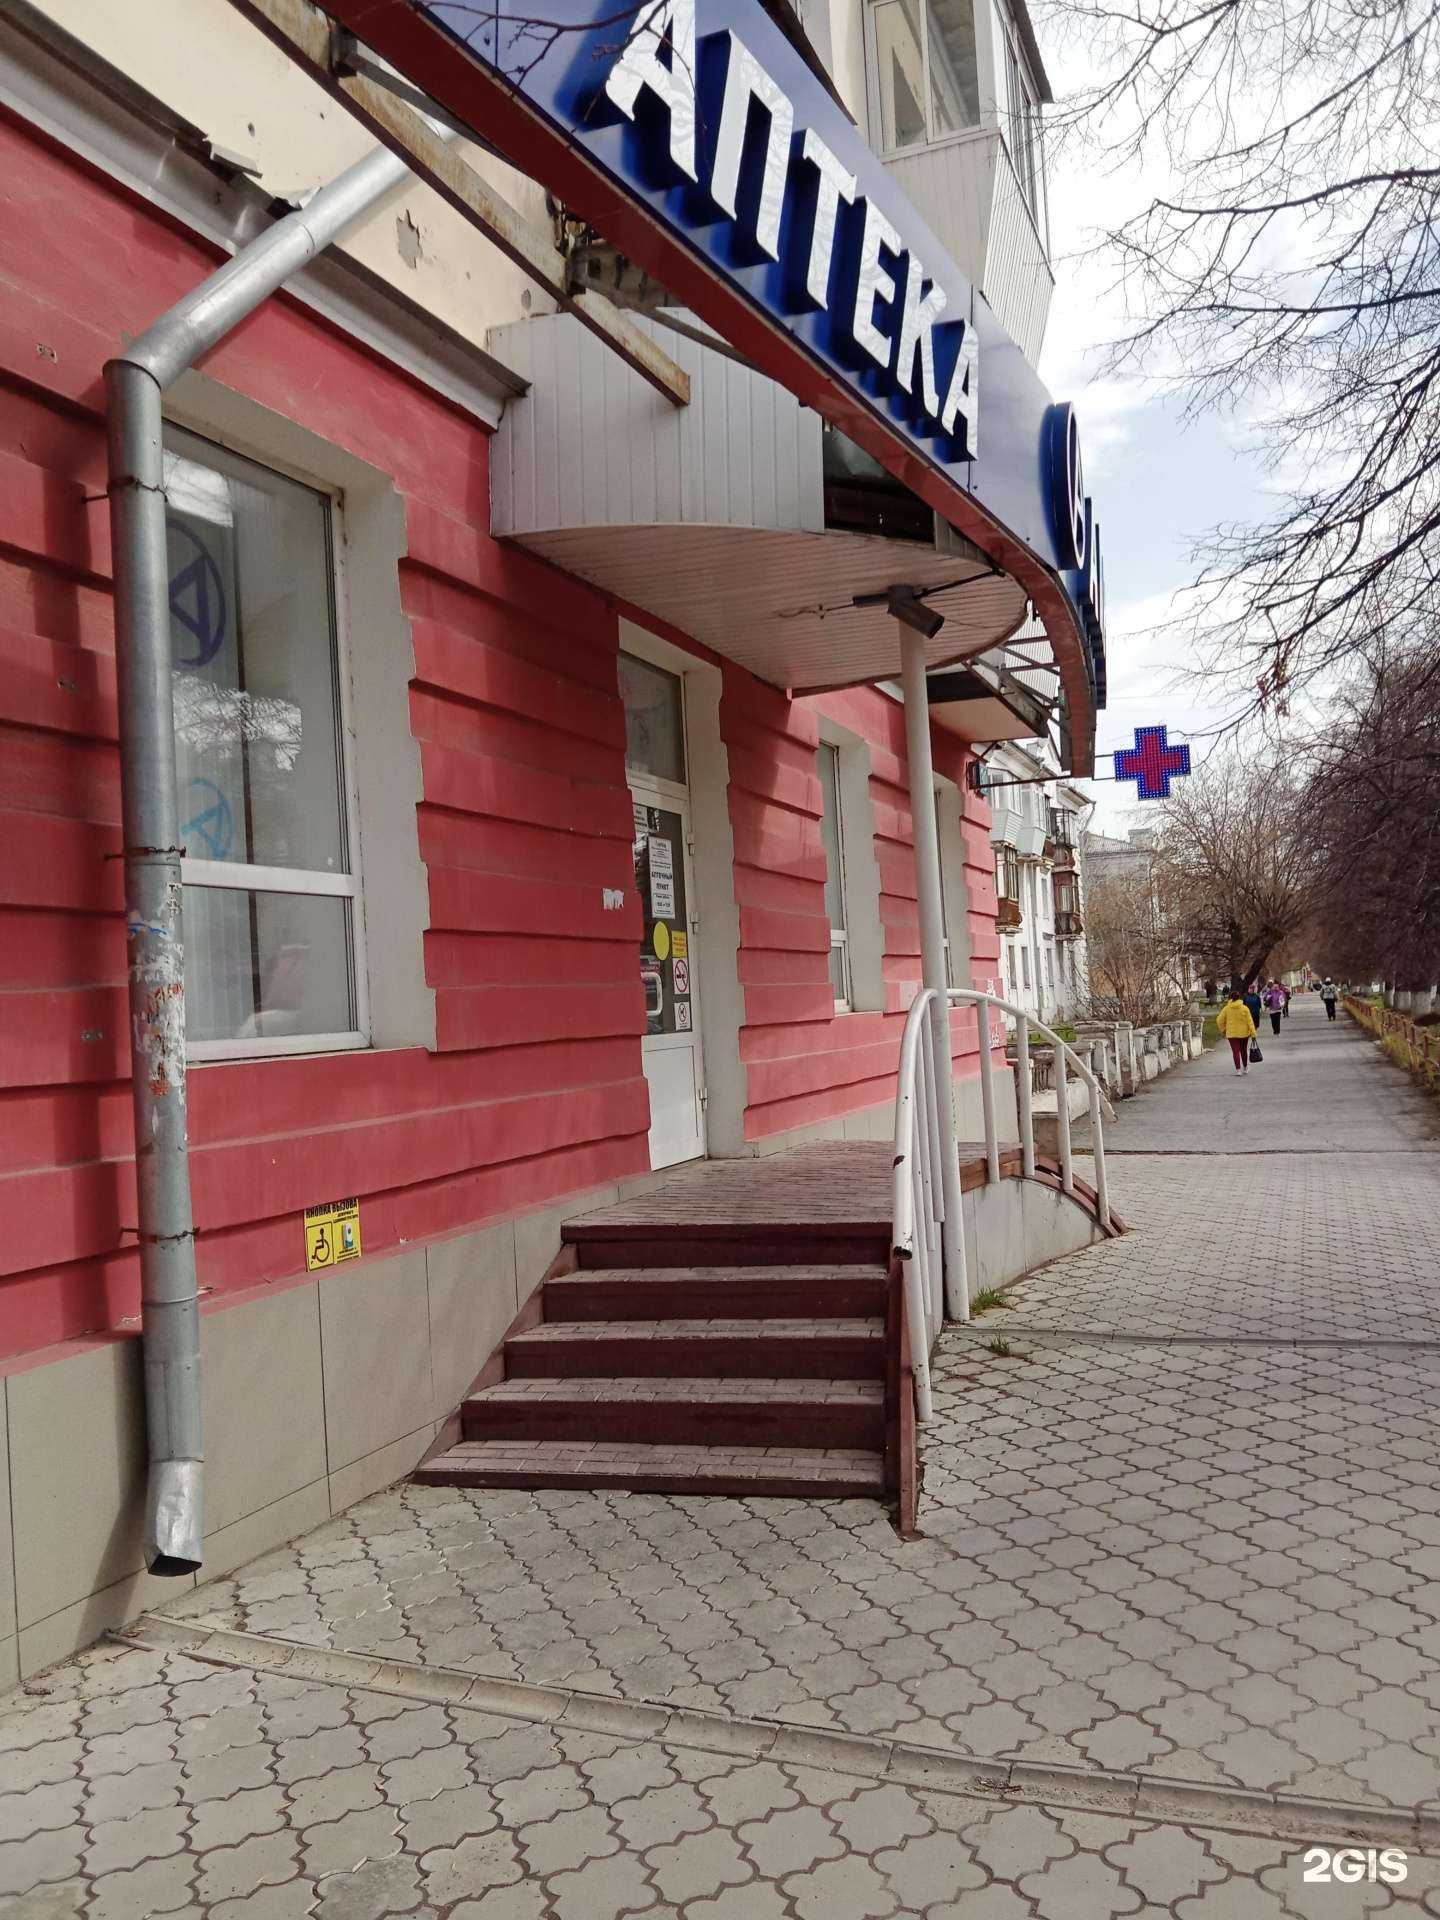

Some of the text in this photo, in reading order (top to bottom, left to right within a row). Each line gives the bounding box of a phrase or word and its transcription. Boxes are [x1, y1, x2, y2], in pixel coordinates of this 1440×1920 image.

[605, 0, 979, 460] АПТЕКА
[305, 1203, 331, 1219] КНОПКА
[331, 1197, 358, 1214] ВЫЗОВА
